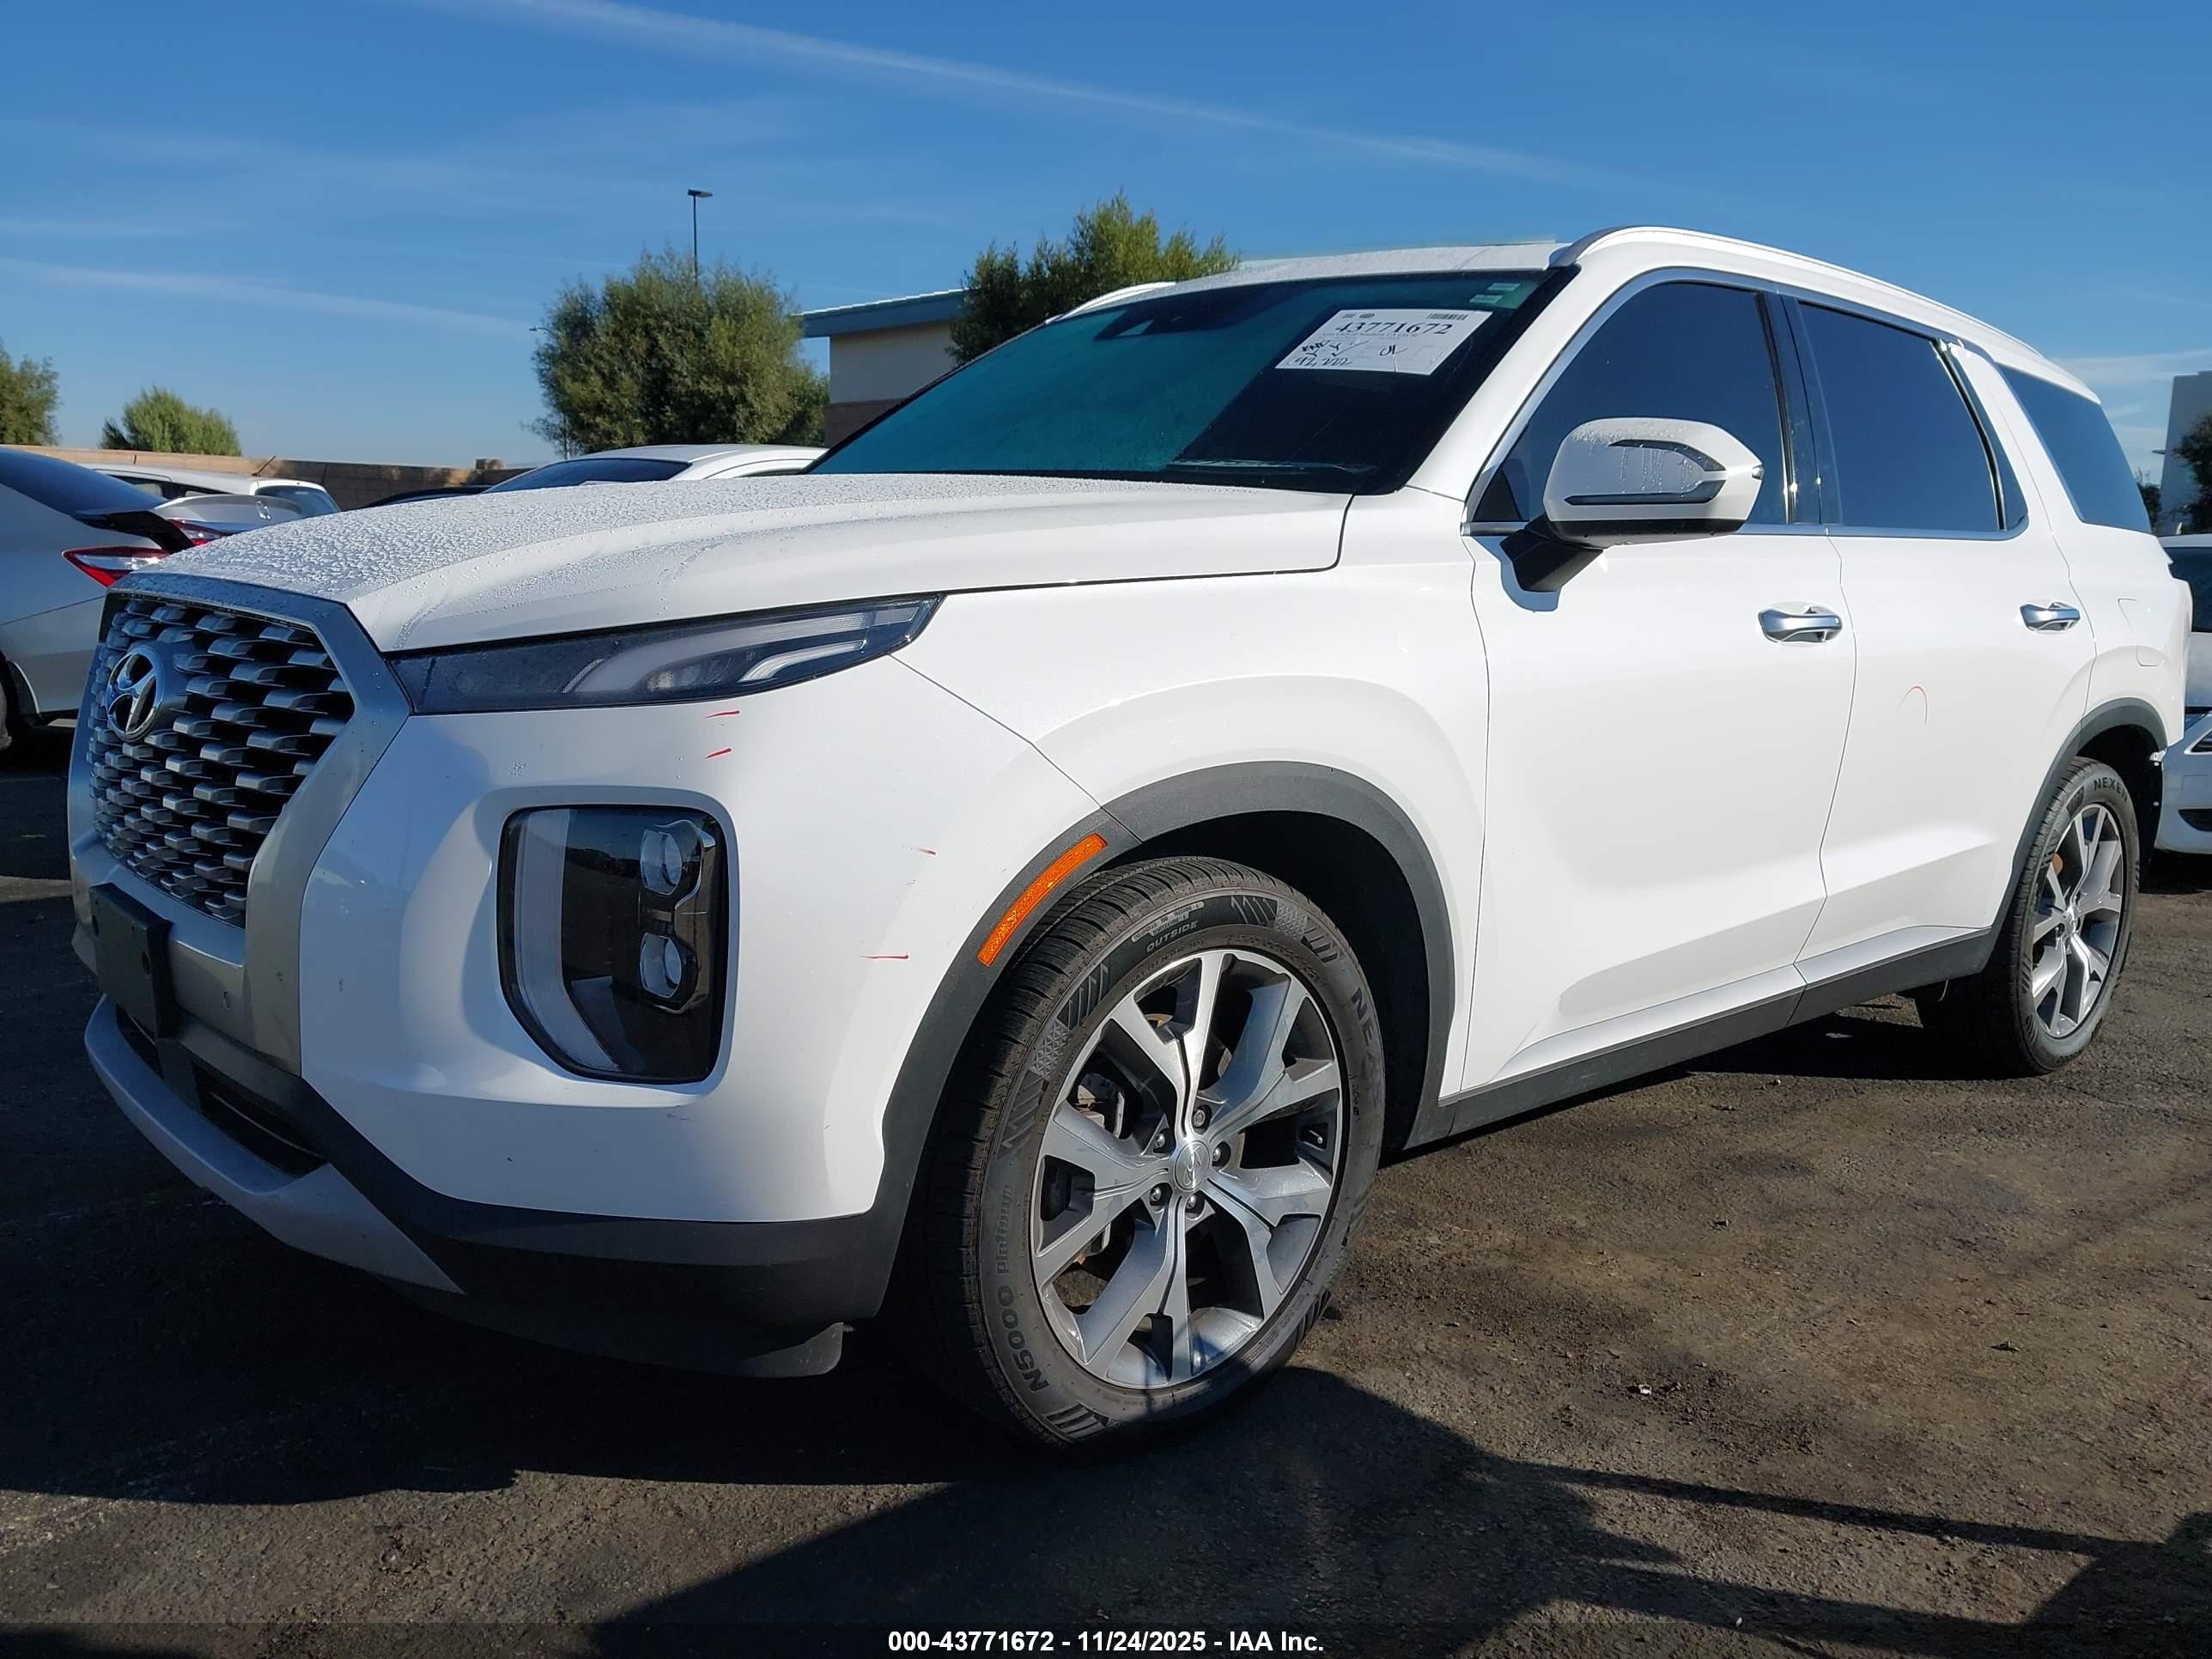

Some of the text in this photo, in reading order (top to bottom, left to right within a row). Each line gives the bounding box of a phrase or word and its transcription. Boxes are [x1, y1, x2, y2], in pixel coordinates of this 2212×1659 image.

[1335, 322, 1453, 334] 43771672
[2094, 776, 2128, 802] NEXEN
[1146, 921, 1198, 952] OUTSIDE
[997, 1285, 1049, 1393] N5000
